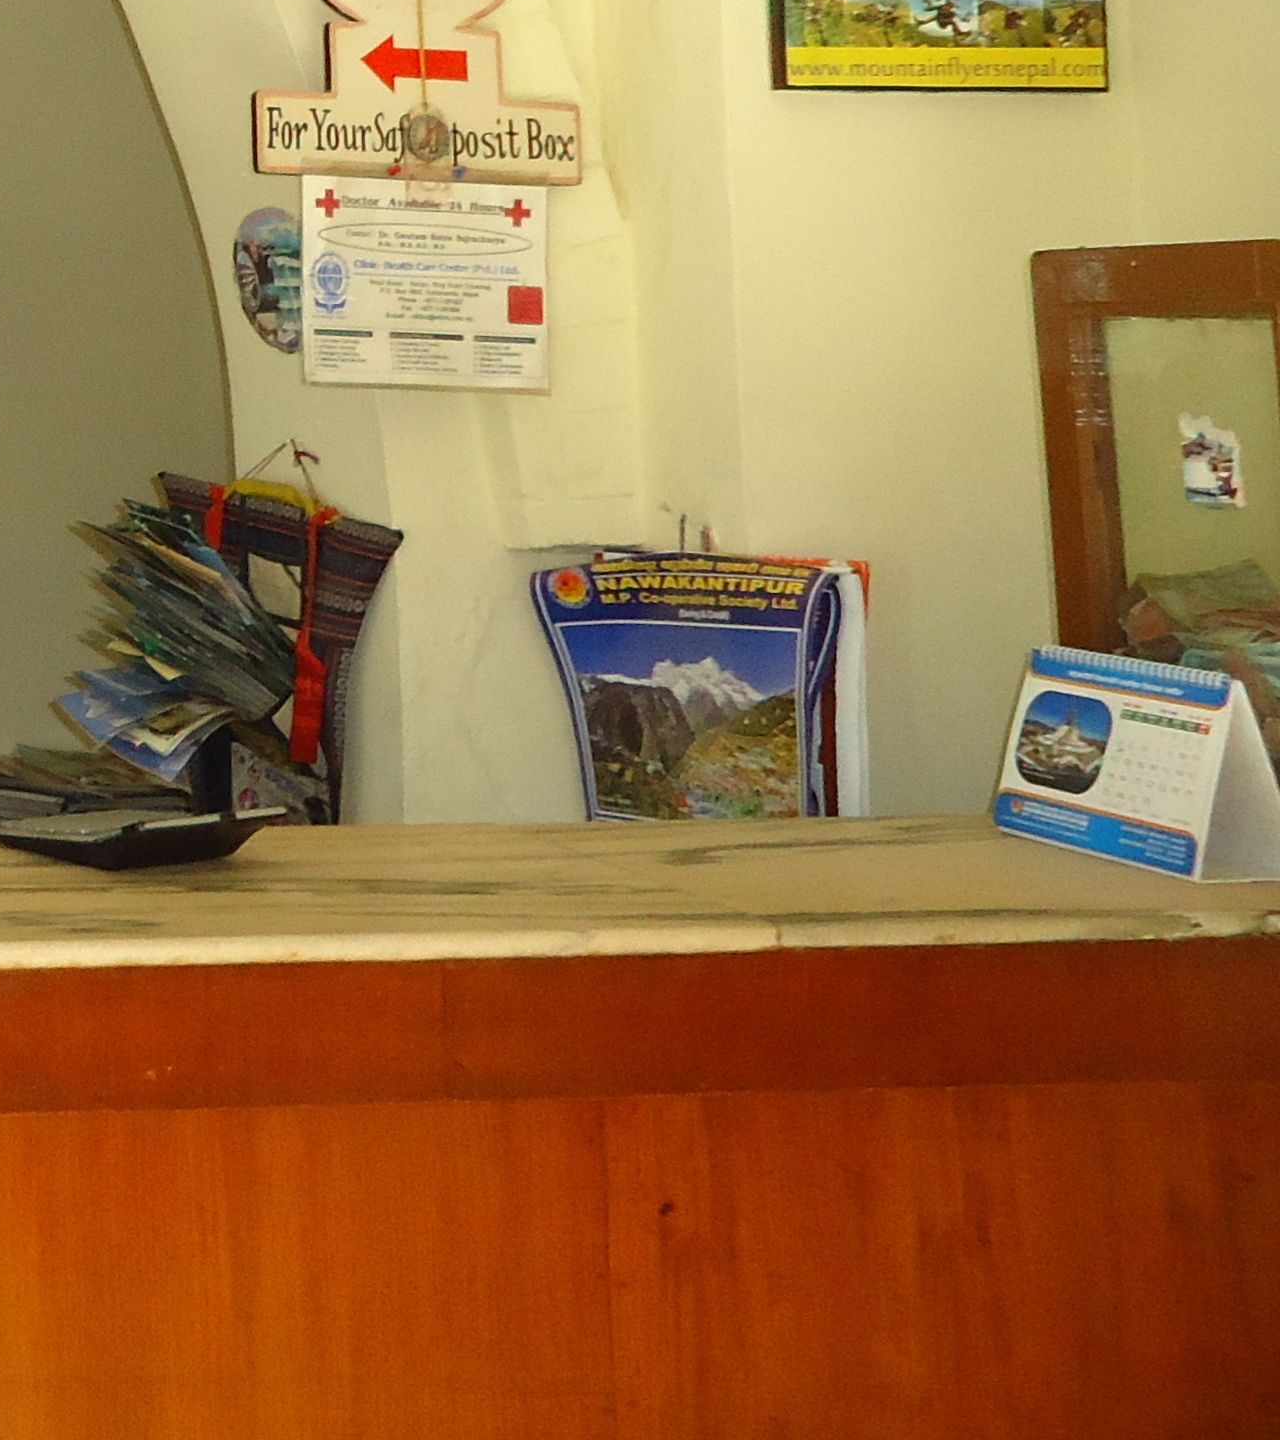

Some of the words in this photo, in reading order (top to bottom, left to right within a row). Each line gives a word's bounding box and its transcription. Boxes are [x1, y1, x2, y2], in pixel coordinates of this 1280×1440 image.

[790, 57, 1106, 84] www.mountainflyersnepal.com
[266, 107, 308, 150] For
[310, 108, 372, 151] Your
[372, 111, 410, 164] Saf
[451, 119, 520, 167] posit
[526, 118, 575, 162] Box
[341, 196, 379, 207] Doctor
[594, 575, 805, 595] NAWAKANTIPUR
